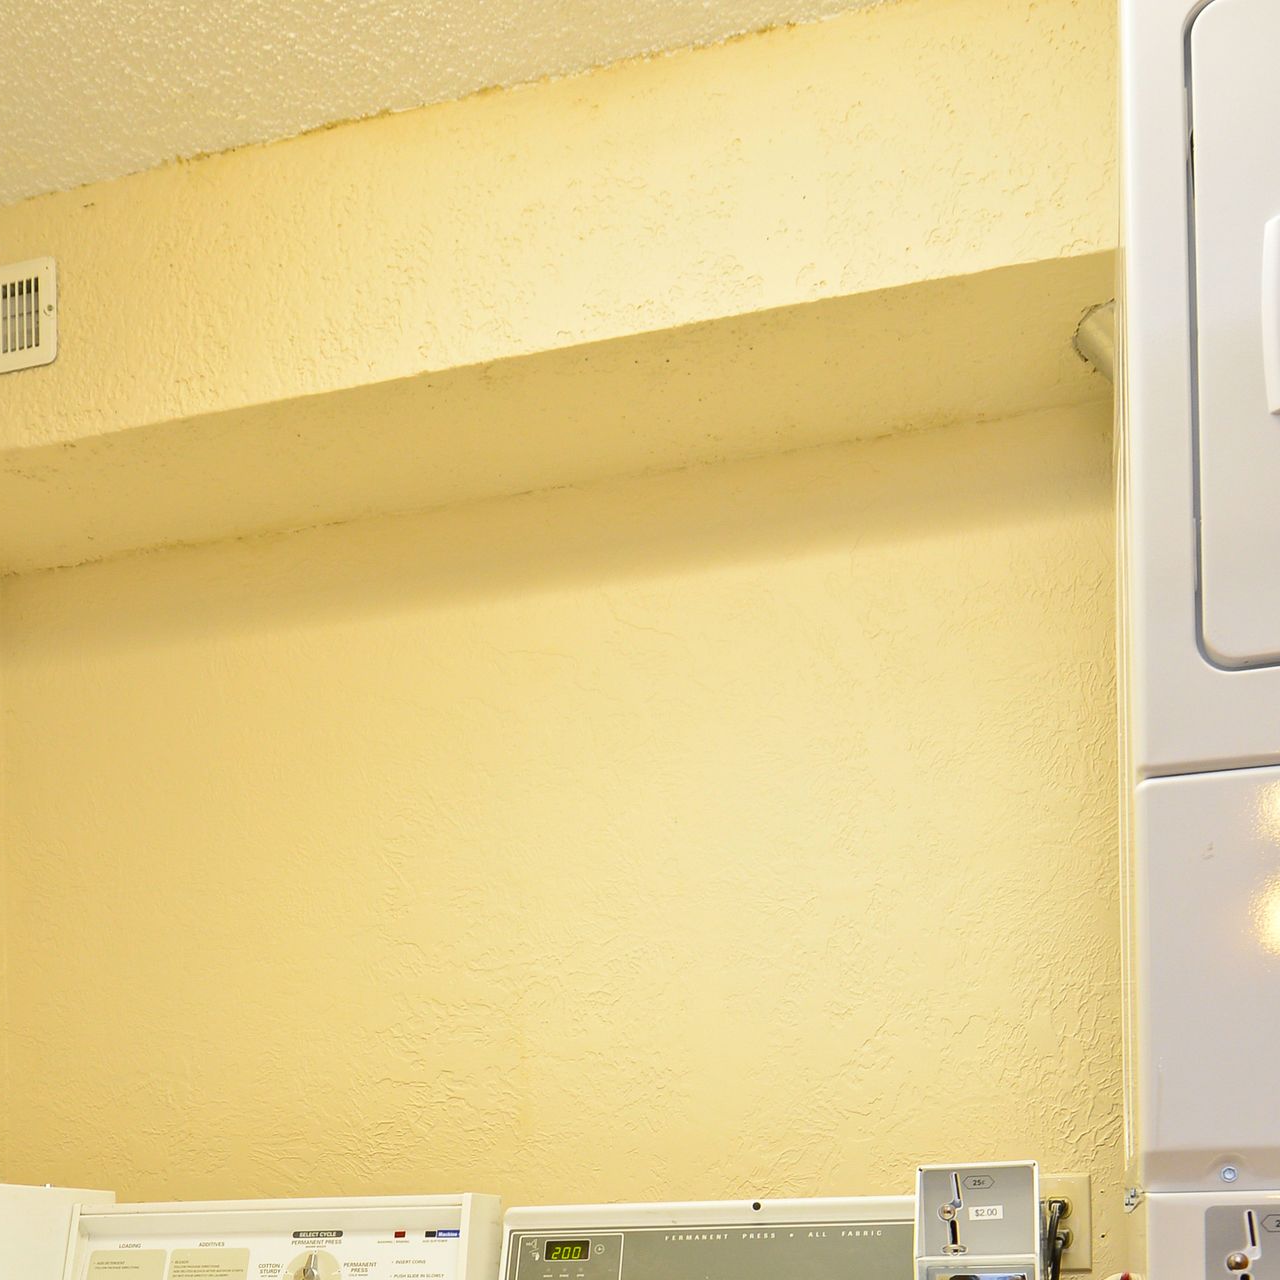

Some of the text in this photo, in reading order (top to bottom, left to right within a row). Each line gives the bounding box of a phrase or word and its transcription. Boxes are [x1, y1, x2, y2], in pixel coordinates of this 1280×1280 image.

[975, 1209, 998, 1217] $2.00
[665, 1233, 729, 1241] PERMANENT
[551, 1246, 582, 1260] 200
